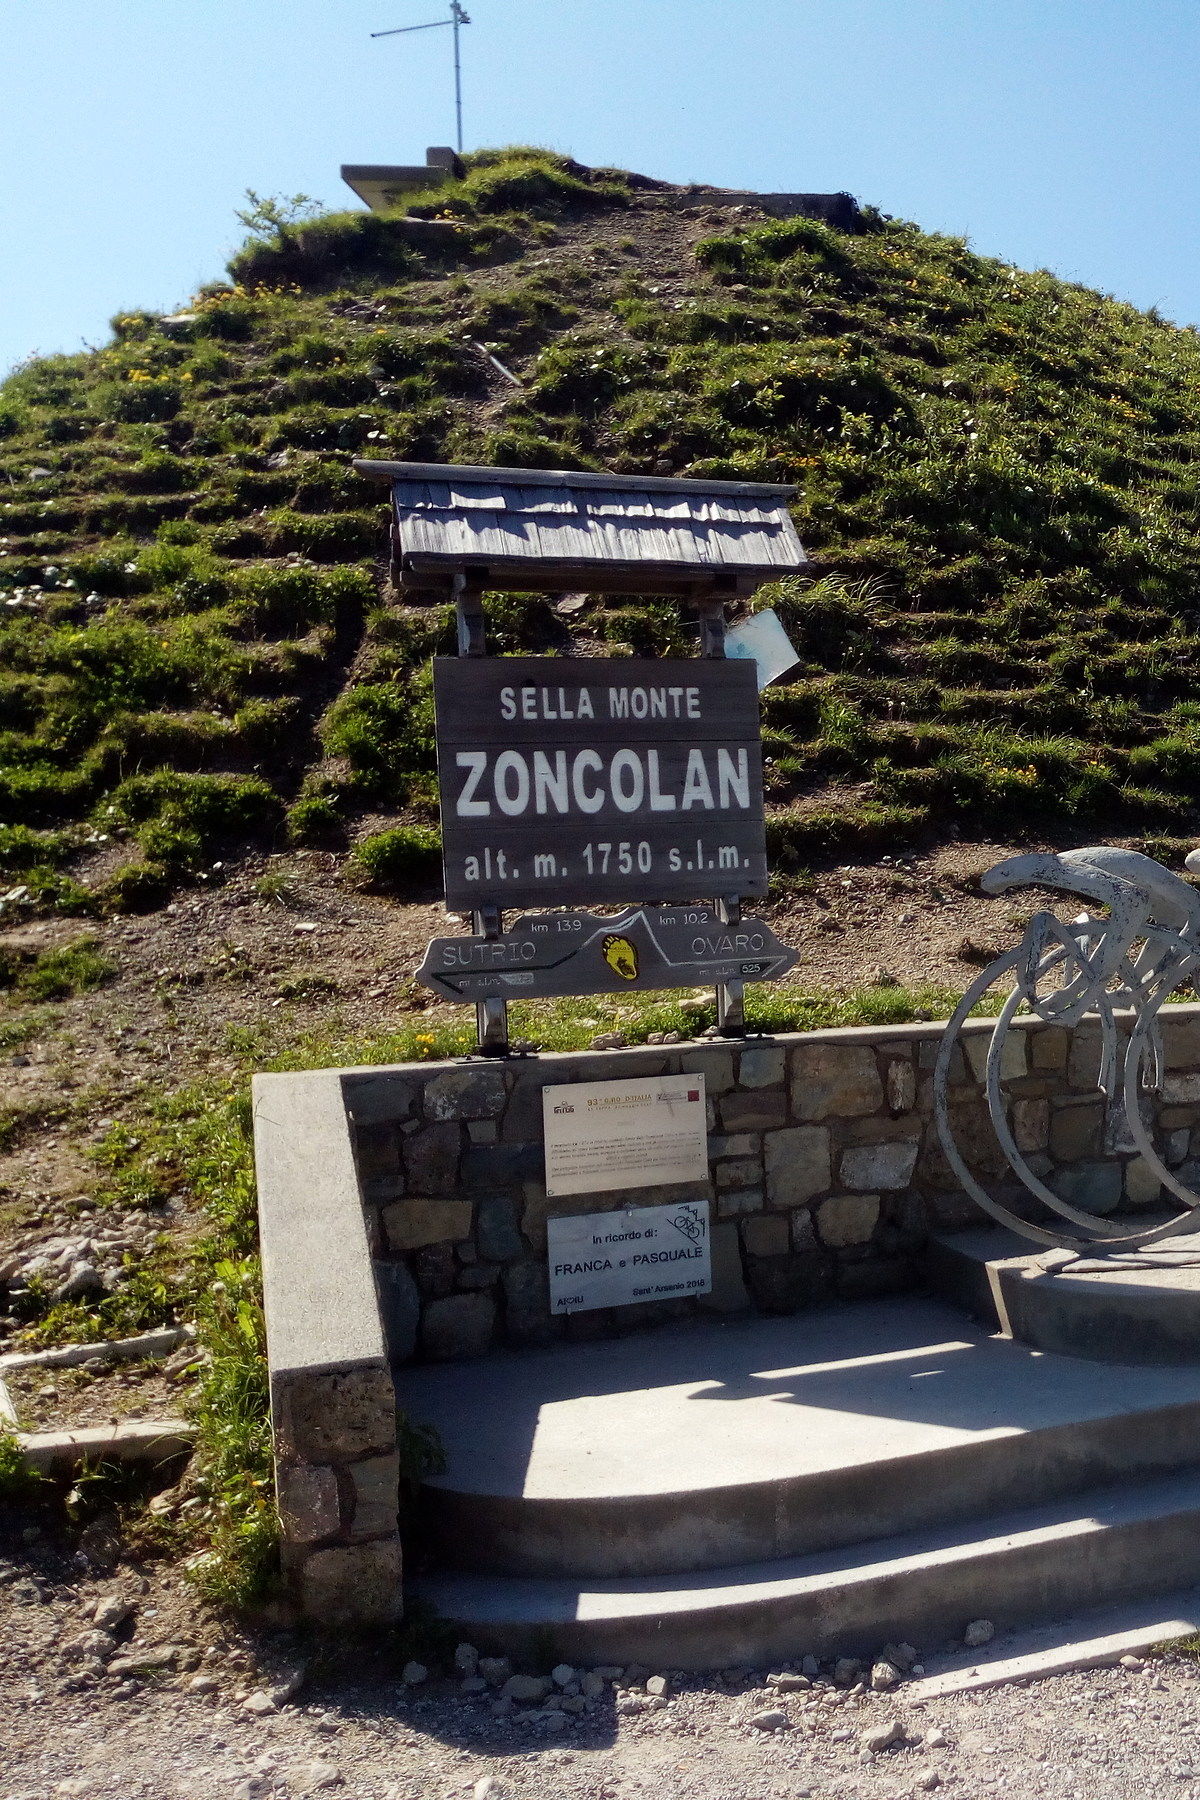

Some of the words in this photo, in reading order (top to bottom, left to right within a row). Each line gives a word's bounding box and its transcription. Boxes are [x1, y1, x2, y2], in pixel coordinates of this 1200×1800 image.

[500, 687, 595, 720] SELLA
[609, 686, 702, 719] MONTE
[455, 748, 752, 818] ZONCOLAN
[464, 848, 520, 881] alt.
[534, 854, 568, 878] m.
[583, 841, 653, 875] 1750
[669, 840, 751, 871] s.l.m.
[531, 922, 549, 933] km
[659, 915, 676, 925] km
[684, 913, 709, 925] 10.2
[442, 942, 537, 966] SUTRIO
[691, 934, 764, 955] OVARO
[742, 964, 761, 974] 525
[592, 1235, 602, 1245] In
[605, 1231, 642, 1243] ricordo
[644, 1228, 658, 1239] di:
[554, 1259, 613, 1276] FRANCA
[619, 1260, 627, 1268] e
[632, 1246, 703, 1266] PASQUALE
